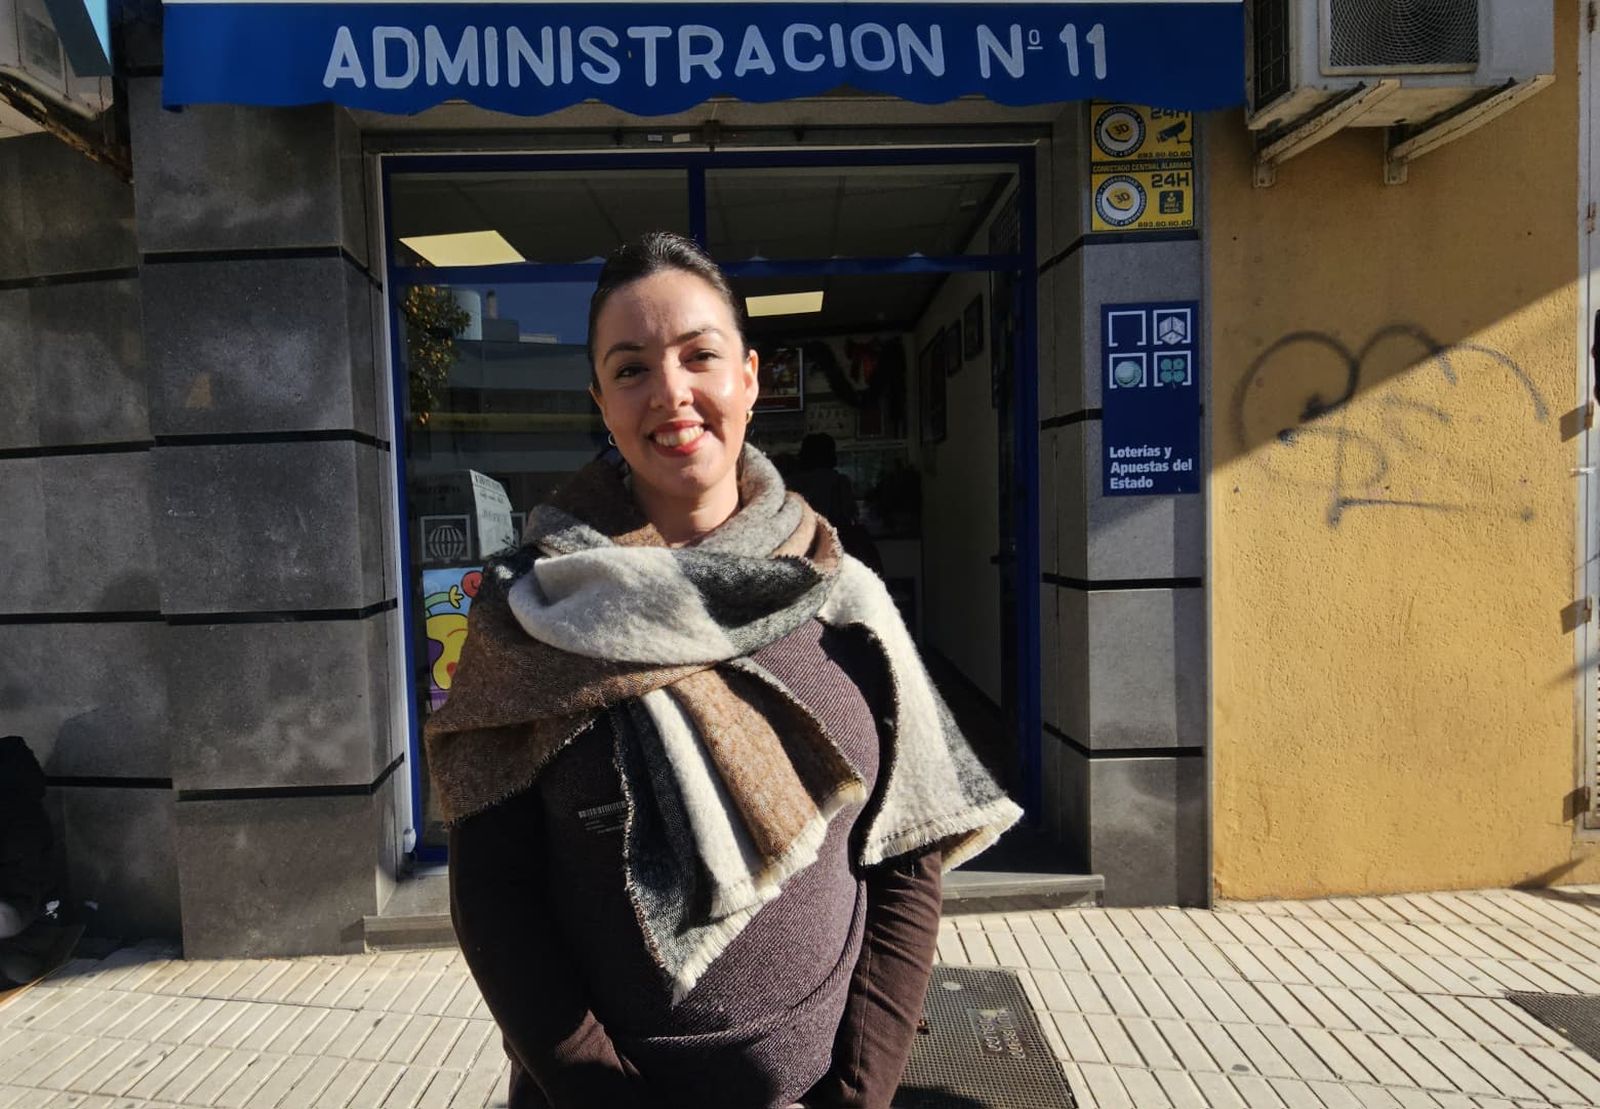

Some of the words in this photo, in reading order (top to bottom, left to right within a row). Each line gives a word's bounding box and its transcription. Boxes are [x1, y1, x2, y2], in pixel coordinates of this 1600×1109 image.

[322, 23, 946, 90] ADMINISTRACION
[976, 23, 1044, 79] Nº
[1059, 23, 1107, 80] 11
[1151, 172, 1189, 188] 24H
[1109, 445, 1160, 458] Loterías
[1164, 446, 1172, 459] y
[1110, 461, 1169, 476] Apuestas
[1172, 458, 1193, 471] del
[1110, 475, 1154, 490] Estado
